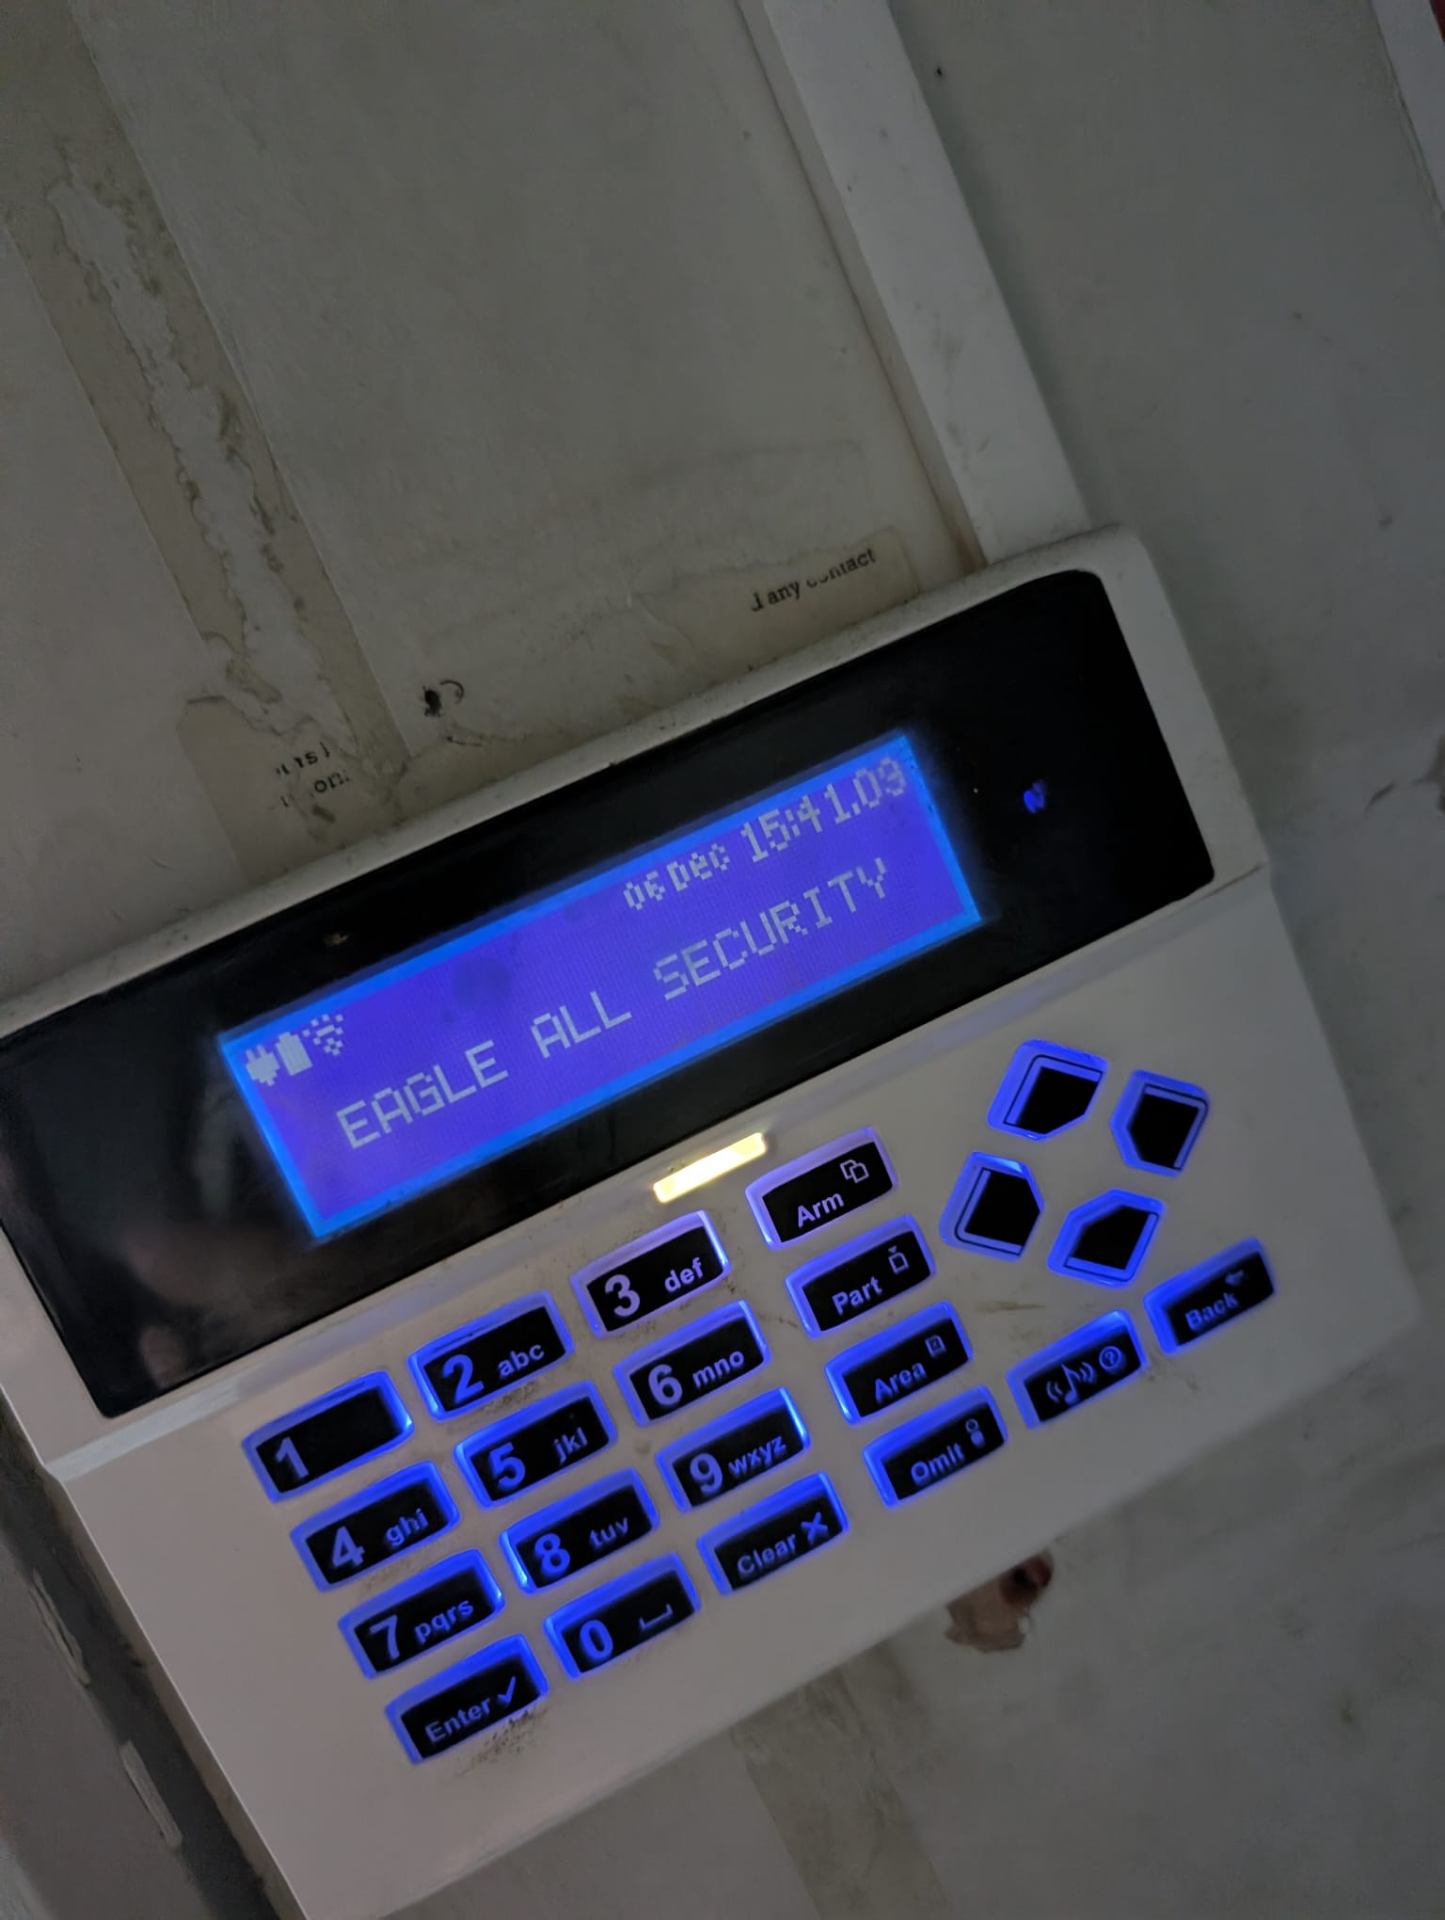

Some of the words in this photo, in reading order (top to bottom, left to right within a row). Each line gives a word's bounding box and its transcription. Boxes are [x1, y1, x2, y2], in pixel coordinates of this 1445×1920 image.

[767, 580, 800, 605] any
[666, 842, 730, 892] Dec
[335, 1040, 508, 1150] EAGLE
[529, 990, 632, 1059] ALL
[652, 857, 888, 1000] SECURITY
[796, 1190, 845, 1228] Arm
[604, 1273, 641, 1318] 3
[663, 1257, 704, 1296] def
[832, 1277, 883, 1316] Part
[1184, 1292, 1240, 1332] Back
[440, 1354, 484, 1402] 2
[496, 1343, 546, 1379] abc
[647, 1364, 684, 1408] 6
[690, 1348, 746, 1389] mno
[872, 1362, 927, 1404] Area
[275, 1437, 309, 1481] 1
[487, 1443, 527, 1489] 5
[551, 1428, 590, 1464] jkl
[688, 1454, 725, 1496] 9
[727, 1434, 788, 1477] wxyz
[910, 1441, 965, 1486] Omit
[329, 1526, 365, 1571] 4
[384, 1508, 430, 1548] ghi
[533, 1533, 570, 1576] 8
[588, 1517, 631, 1550] tuv
[736, 1535, 798, 1577] Clear
[368, 1615, 401, 1661] 7
[413, 1599, 475, 1645] pqrs
[578, 1621, 613, 1662] 0
[423, 1697, 491, 1745] Enter
